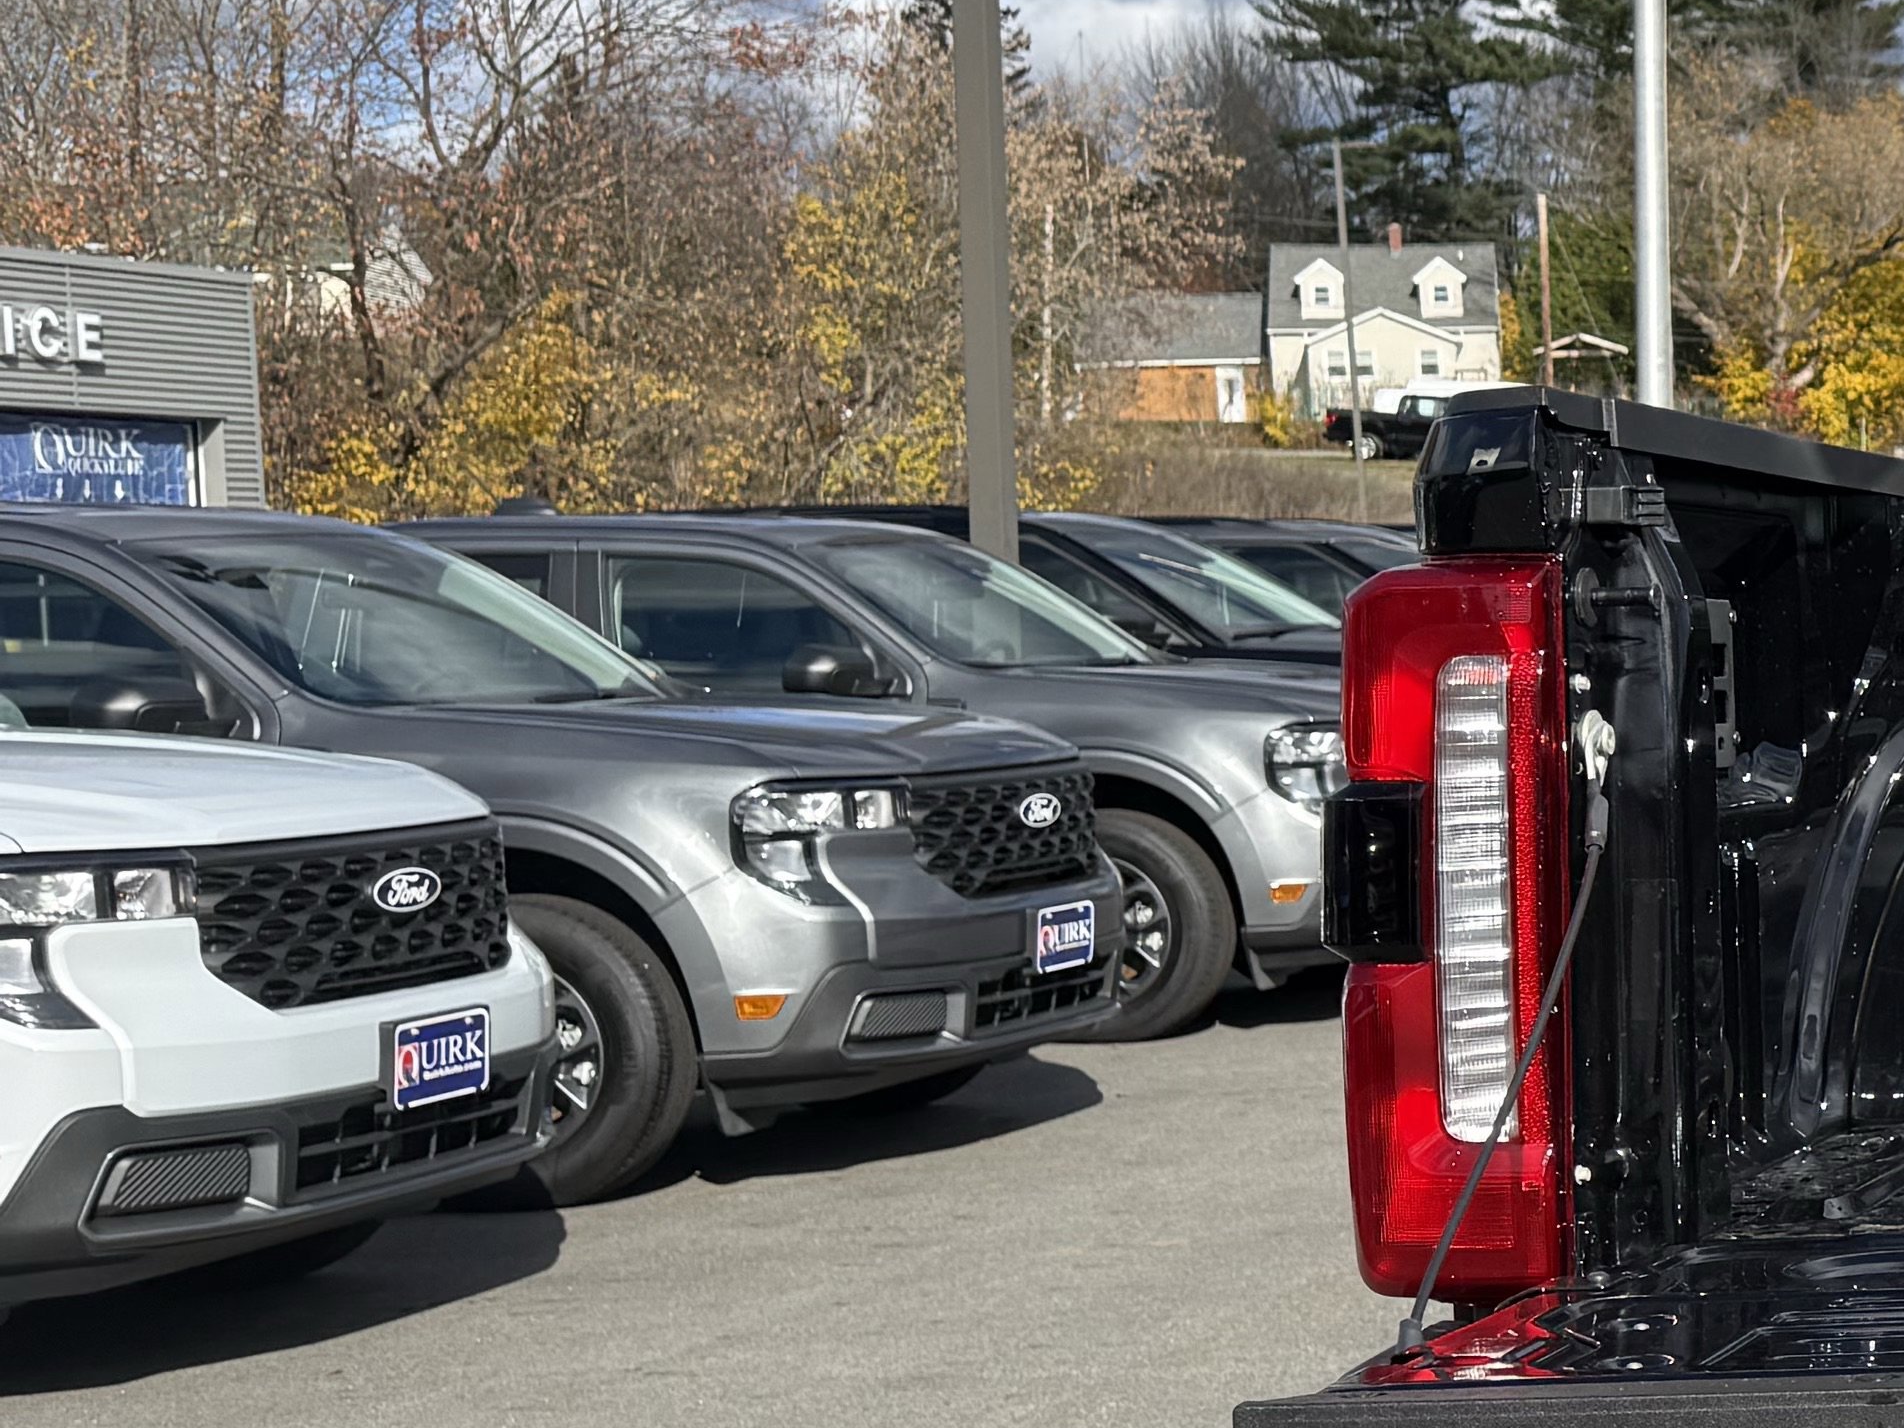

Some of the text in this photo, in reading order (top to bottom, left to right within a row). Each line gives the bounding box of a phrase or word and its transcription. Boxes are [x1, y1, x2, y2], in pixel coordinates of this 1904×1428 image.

[2, 305, 103, 362] ICE
[31, 424, 144, 473] QUIRK
[386, 873, 430, 907] Ford
[1040, 919, 1091, 956] QUIRK
[398, 1030, 484, 1089] QUIRK
